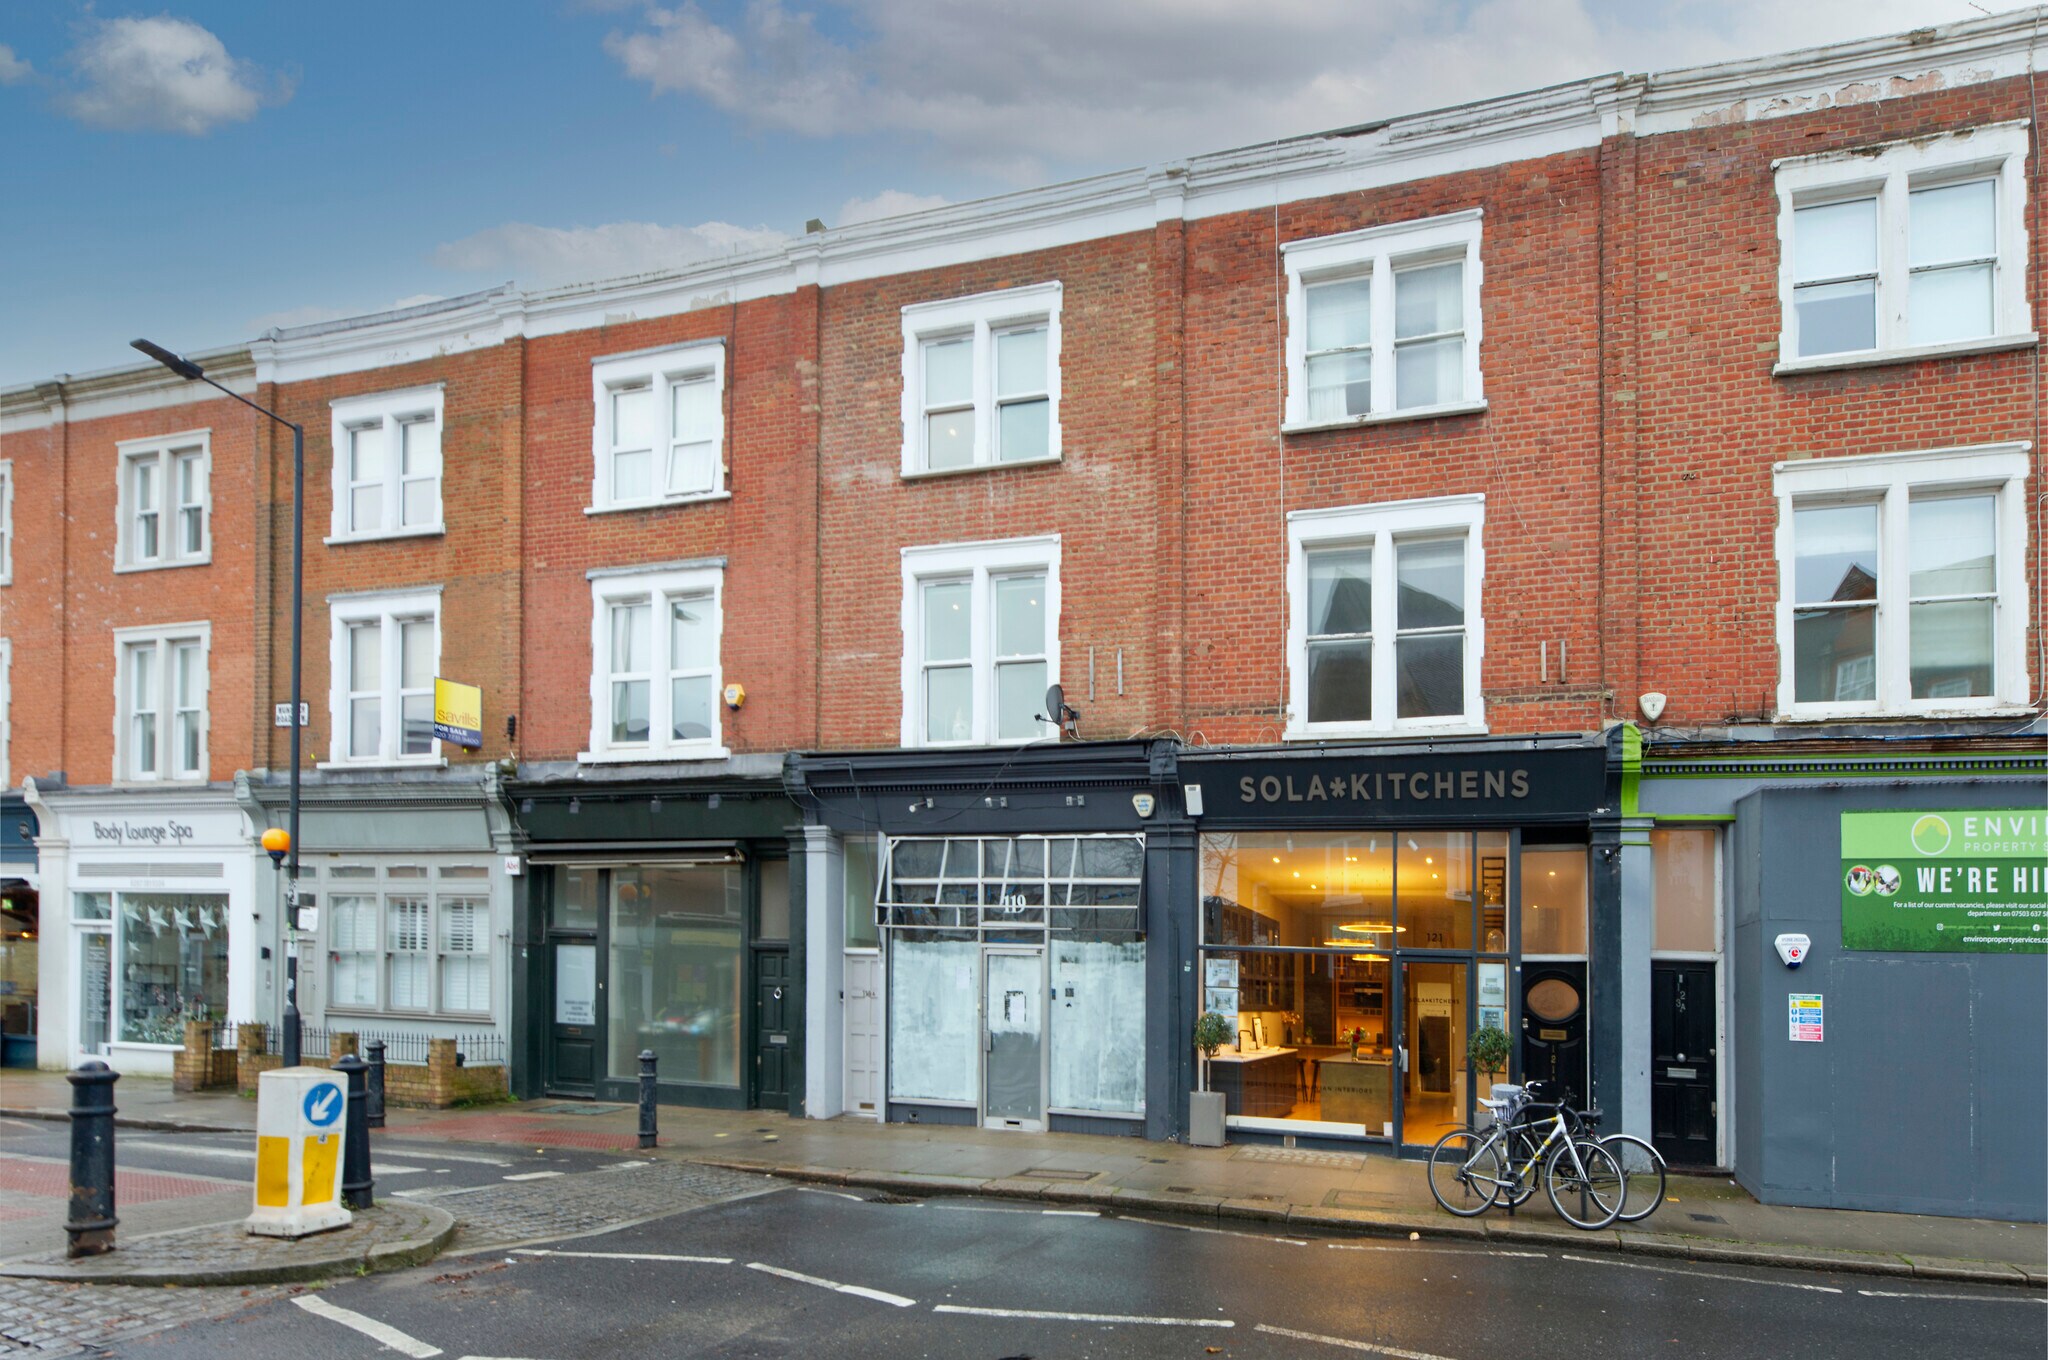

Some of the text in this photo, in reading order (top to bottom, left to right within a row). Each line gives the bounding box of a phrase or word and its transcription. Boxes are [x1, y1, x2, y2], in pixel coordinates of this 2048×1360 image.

[436, 709, 479, 729] savills
[434, 723, 468, 736] FOR SALE
[92, 819, 194, 846] Body Lounge Spa
[1963, 841, 2038, 853] PROPERTY
[1003, 894, 1026, 914] 119
[1893, 901, 1903, 909] For
[1908, 901, 1916, 909] list
[1917, 901, 1924, 909] of
[1985, 901, 2005, 910] please
[2005, 901, 2018, 909] visit
[2029, 901, 2047, 910] social
[1967, 910, 2001, 918] department
[1426, 932, 1443, 943] 121
[1334, 1086, 1374, 1095] INTERIORS
